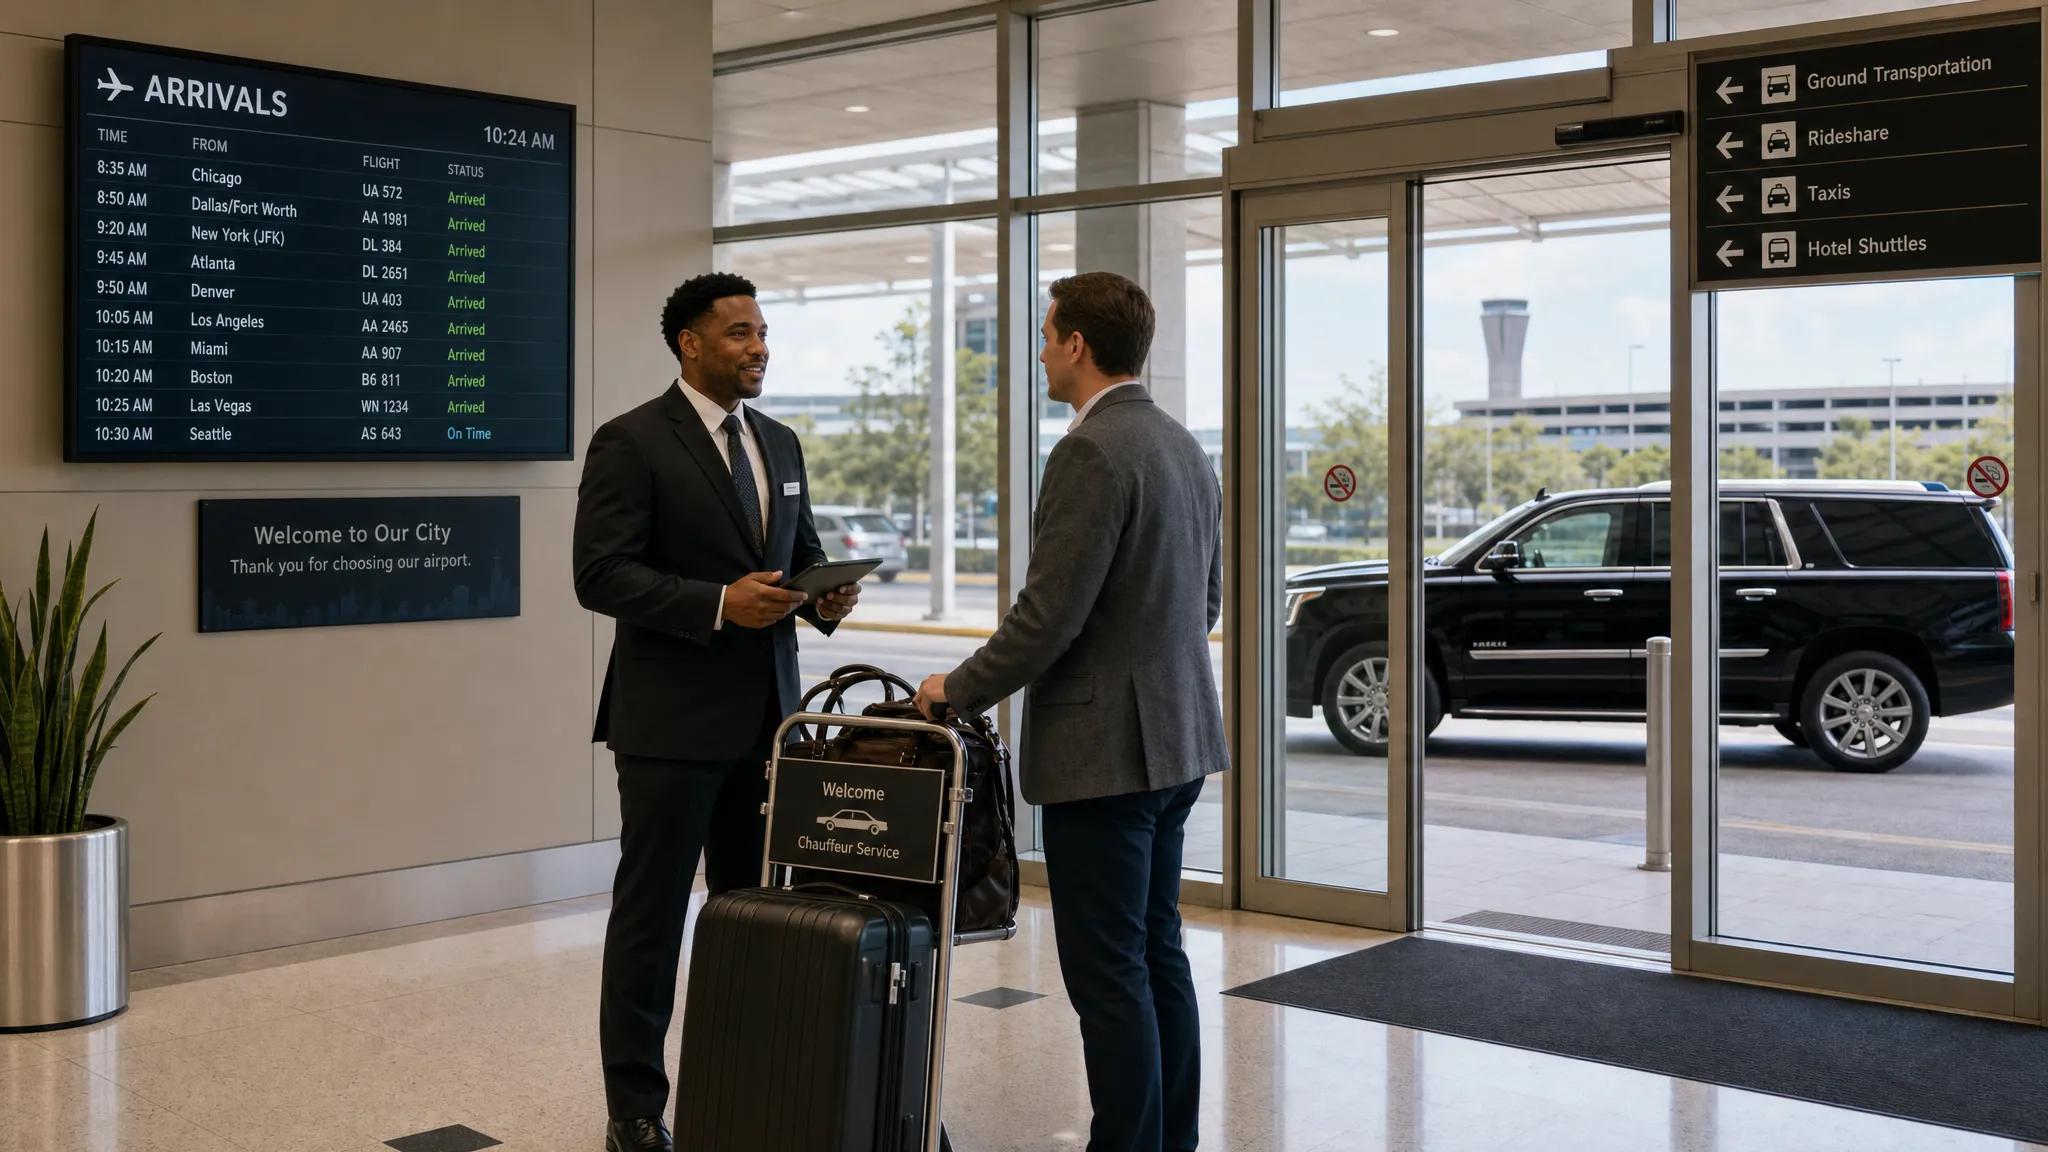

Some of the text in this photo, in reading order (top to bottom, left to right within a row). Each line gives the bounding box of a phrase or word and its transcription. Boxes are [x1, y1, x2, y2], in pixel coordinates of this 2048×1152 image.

[1807, 56, 1991, 89] Ground Transportation
[144, 75, 287, 117] ARRIVALS
[97, 128, 127, 143] TIME
[484, 126, 554, 150] 10:24 AM
[1808, 126, 1889, 146] Rideshare
[193, 137, 227, 152] FROM
[97, 160, 147, 177] 8:35 AM
[363, 155, 400, 170] FLIGHT
[192, 168, 242, 188] Chicago
[448, 163, 484, 178] STATUS
[97, 190, 147, 207] 8:50 AM
[363, 183, 402, 199] UA 572
[448, 191, 485, 206] Arrived
[1807, 184, 1851, 201] Taxis
[192, 196, 297, 218] Dallas/Fort Worth
[362, 210, 407, 226] AA 1981
[448, 217, 485, 232] Arrived
[97, 220, 147, 236] 9:20 AM
[192, 225, 284, 247] New York (JFK)
[363, 237, 402, 253] DL 384
[448, 243, 485, 258] Arrived
[1808, 235, 1927, 257] Hotel Shuttles
[97, 250, 147, 266] 9:45 AM
[191, 254, 235, 270] Atlanta
[363, 265, 407, 280] DL 2651
[448, 270, 485, 284] Arrived
[97, 280, 147, 295] 9:50 AM
[191, 283, 235, 298] Denver
[362, 292, 402, 306] UA 403
[448, 296, 485, 310] Arrived
[96, 309, 153, 325] 10:05 AM
[191, 312, 264, 331] Los Angeles
[362, 319, 408, 333] AA 2465
[447, 322, 485, 336] Arrived
[96, 339, 152, 354] 10:15 AM
[191, 341, 228, 355] Miami
[361, 346, 402, 360] AA 907
[447, 348, 485, 361] Arrived
[96, 368, 152, 383] 10:20 AM
[191, 370, 232, 384] Boston
[362, 373, 400, 386] B6 811
[448, 374, 485, 387] Arrived
[96, 397, 152, 412] 10:25 AM
[190, 398, 252, 416] Las Vegas
[361, 400, 409, 413] WN 1234
[447, 400, 485, 413] Arrived
[95, 427, 152, 441] 10:30 AM
[190, 426, 232, 440] Seattle
[361, 426, 401, 440] AS 643
[447, 427, 491, 440] On Time
[254, 522, 451, 545] Welcome to Our City
[230, 553, 471, 576] Thank you for choosing our airport.
[823, 781, 884, 801] Welcome
[798, 836, 900, 859] Chauffeur Service
